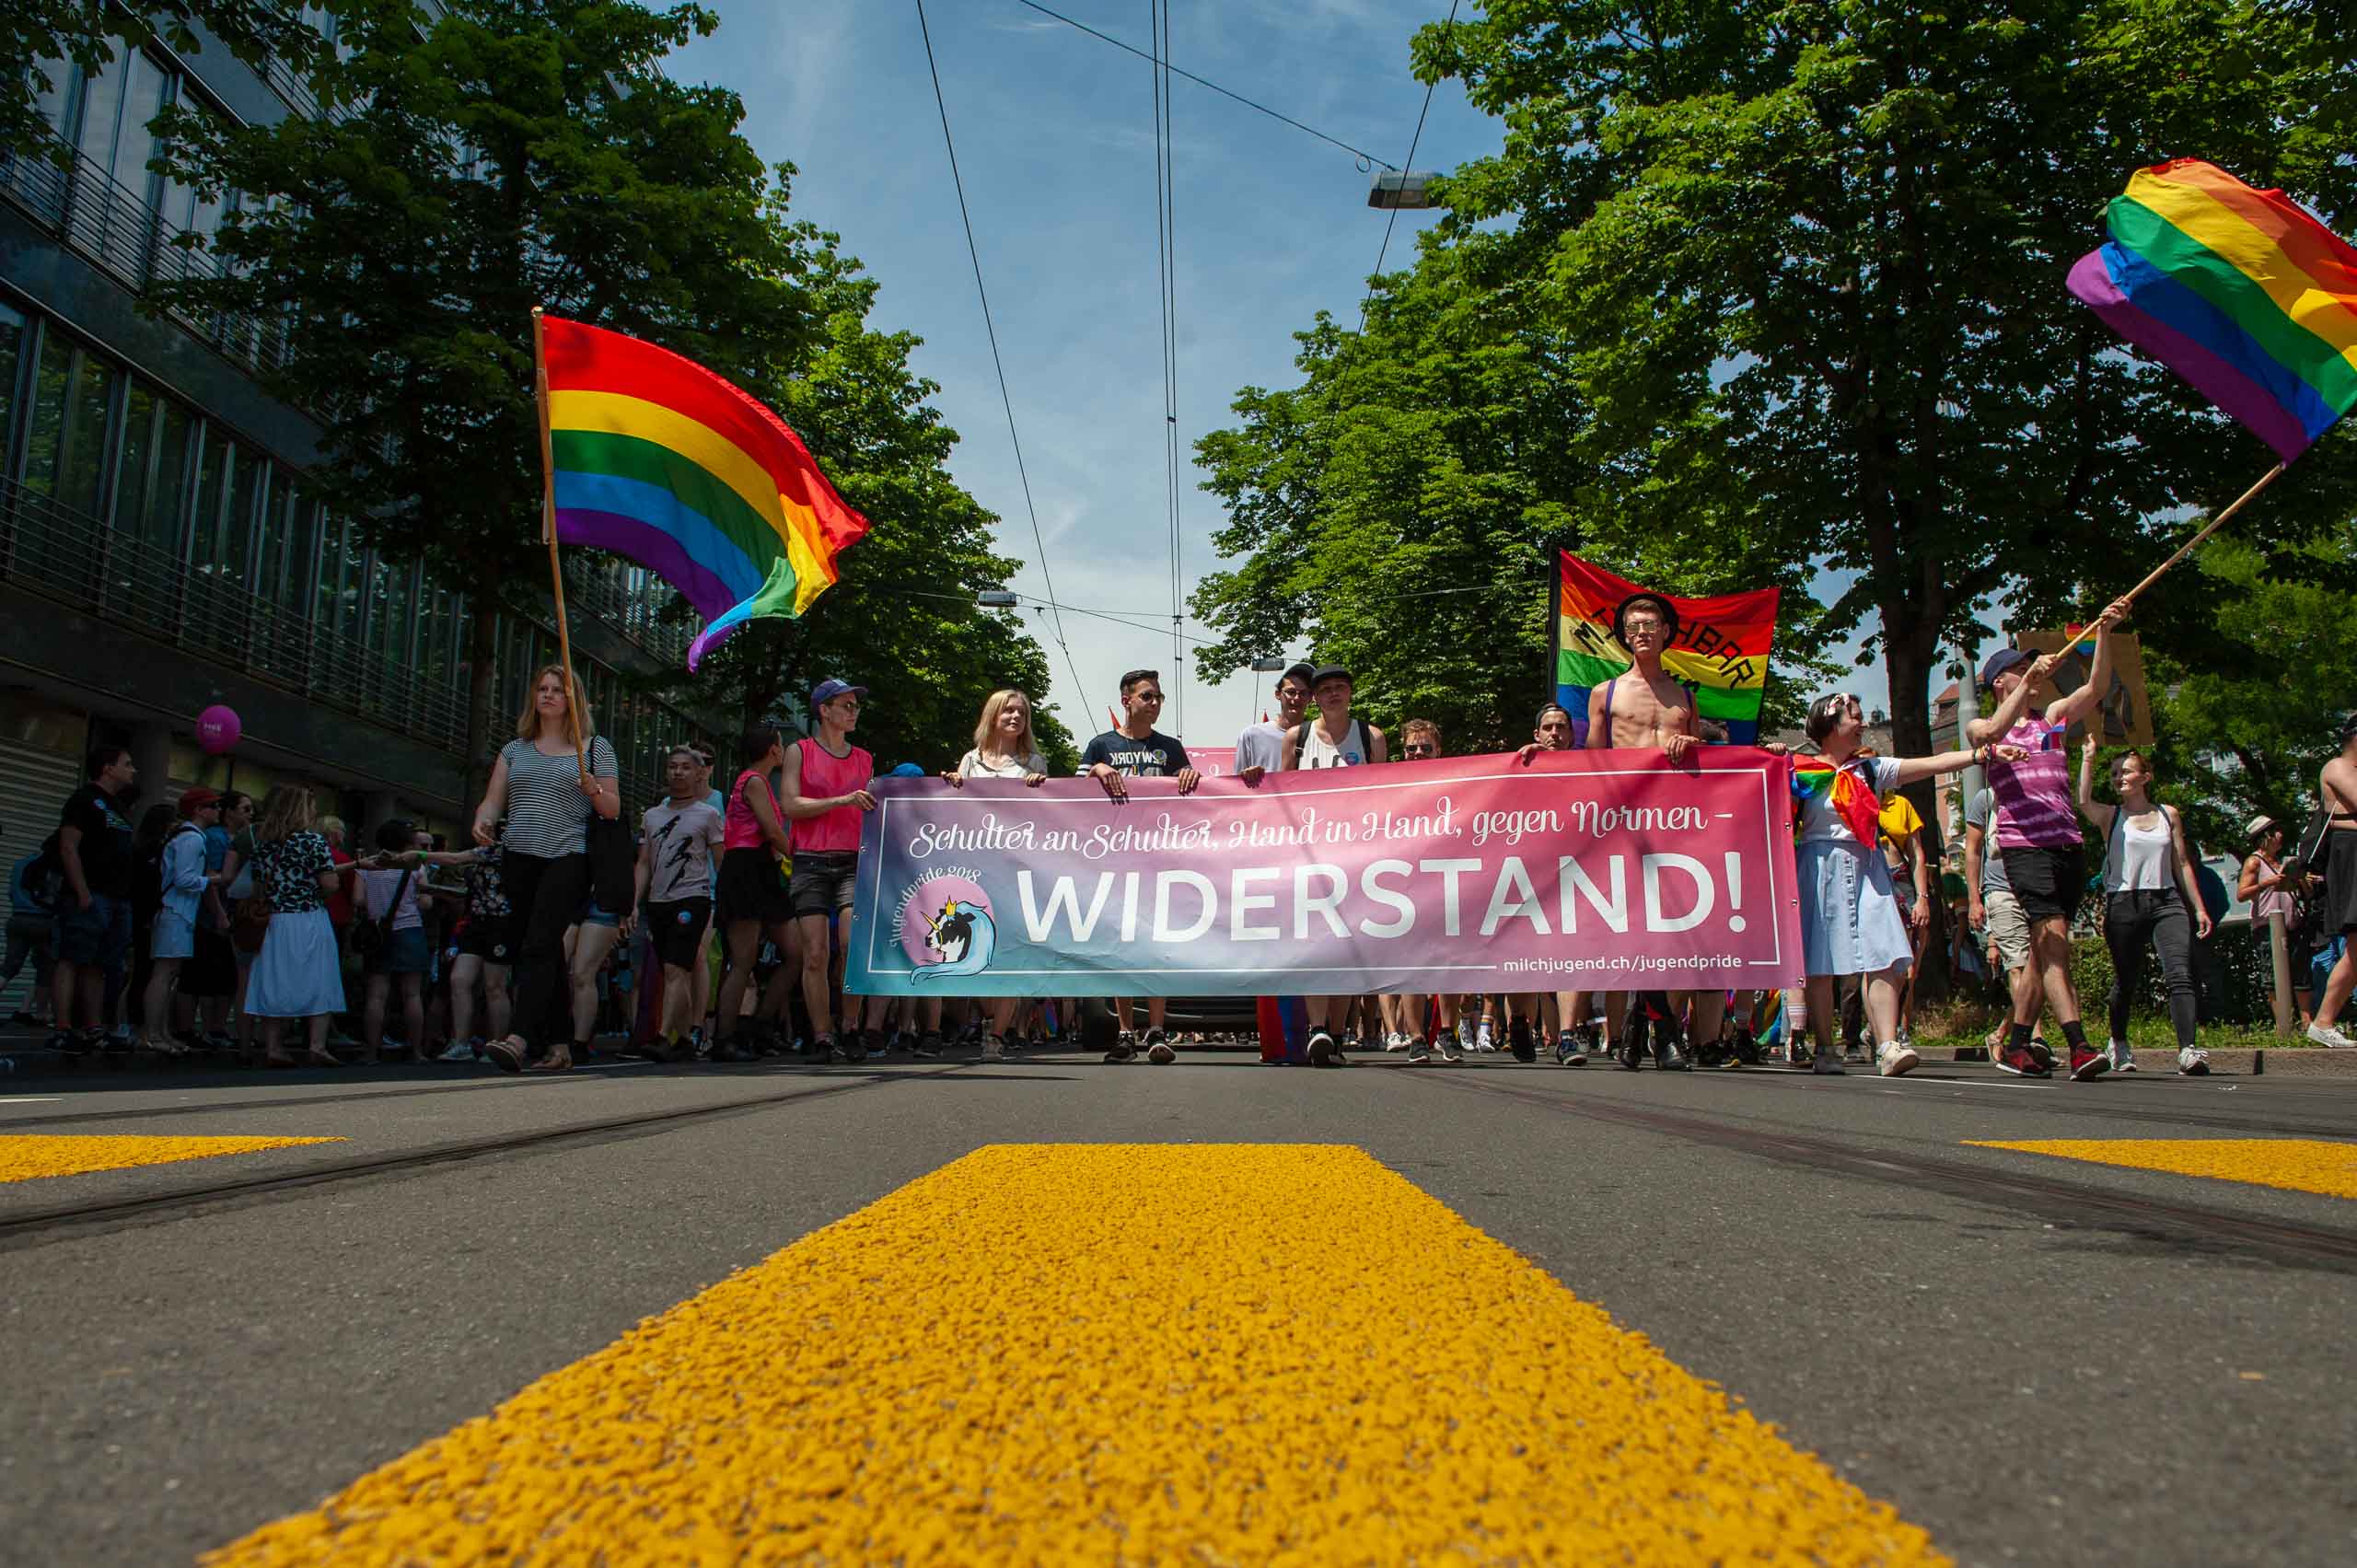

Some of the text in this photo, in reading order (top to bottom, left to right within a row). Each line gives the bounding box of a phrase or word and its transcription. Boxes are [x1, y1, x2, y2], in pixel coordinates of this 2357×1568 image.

[1573, 607, 1755, 691] MIHBAR
[910, 813, 1038, 858] Schulter
[1042, 830, 1083, 852] an
[1083, 812, 1220, 860] Schulter,
[1228, 807, 1325, 849] Hand
[1325, 819, 1357, 842] in
[1362, 796, 1462, 841] Hand,
[1472, 809, 1564, 846] gegen
[1571, 801, 1708, 839] Normen
[888, 865, 981, 947] Jugendpride 2018
[1016, 851, 1747, 943] WIDERSTAND!
[1504, 954, 1742, 973] milchjugend.ch/jugendpride
